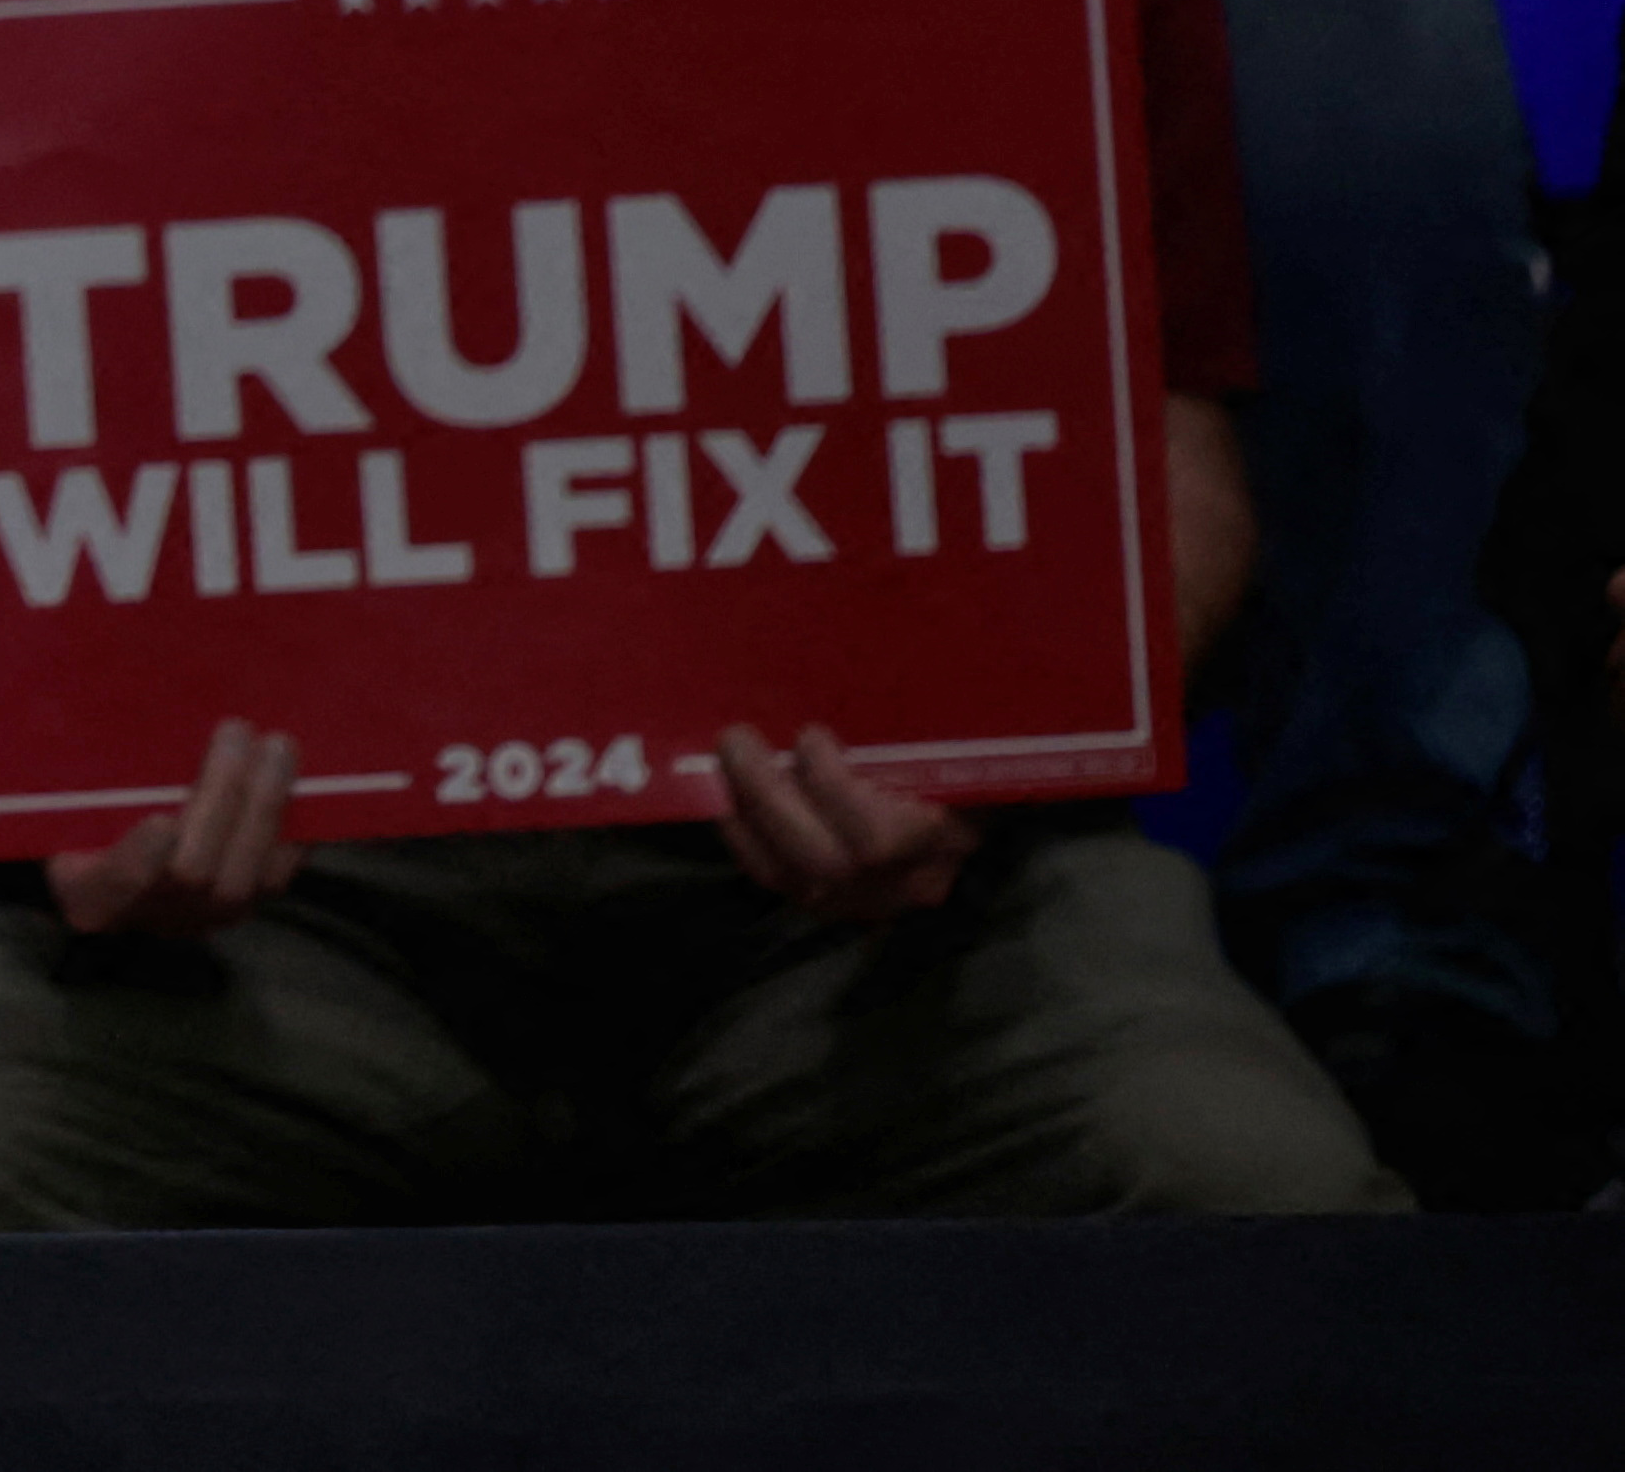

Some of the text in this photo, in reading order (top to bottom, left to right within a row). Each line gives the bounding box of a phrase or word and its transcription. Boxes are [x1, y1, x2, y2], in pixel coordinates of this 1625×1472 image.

[522, 422, 837, 579] FIX
[886, 408, 1060, 556] IT
[434, 733, 653, 805] 2024
